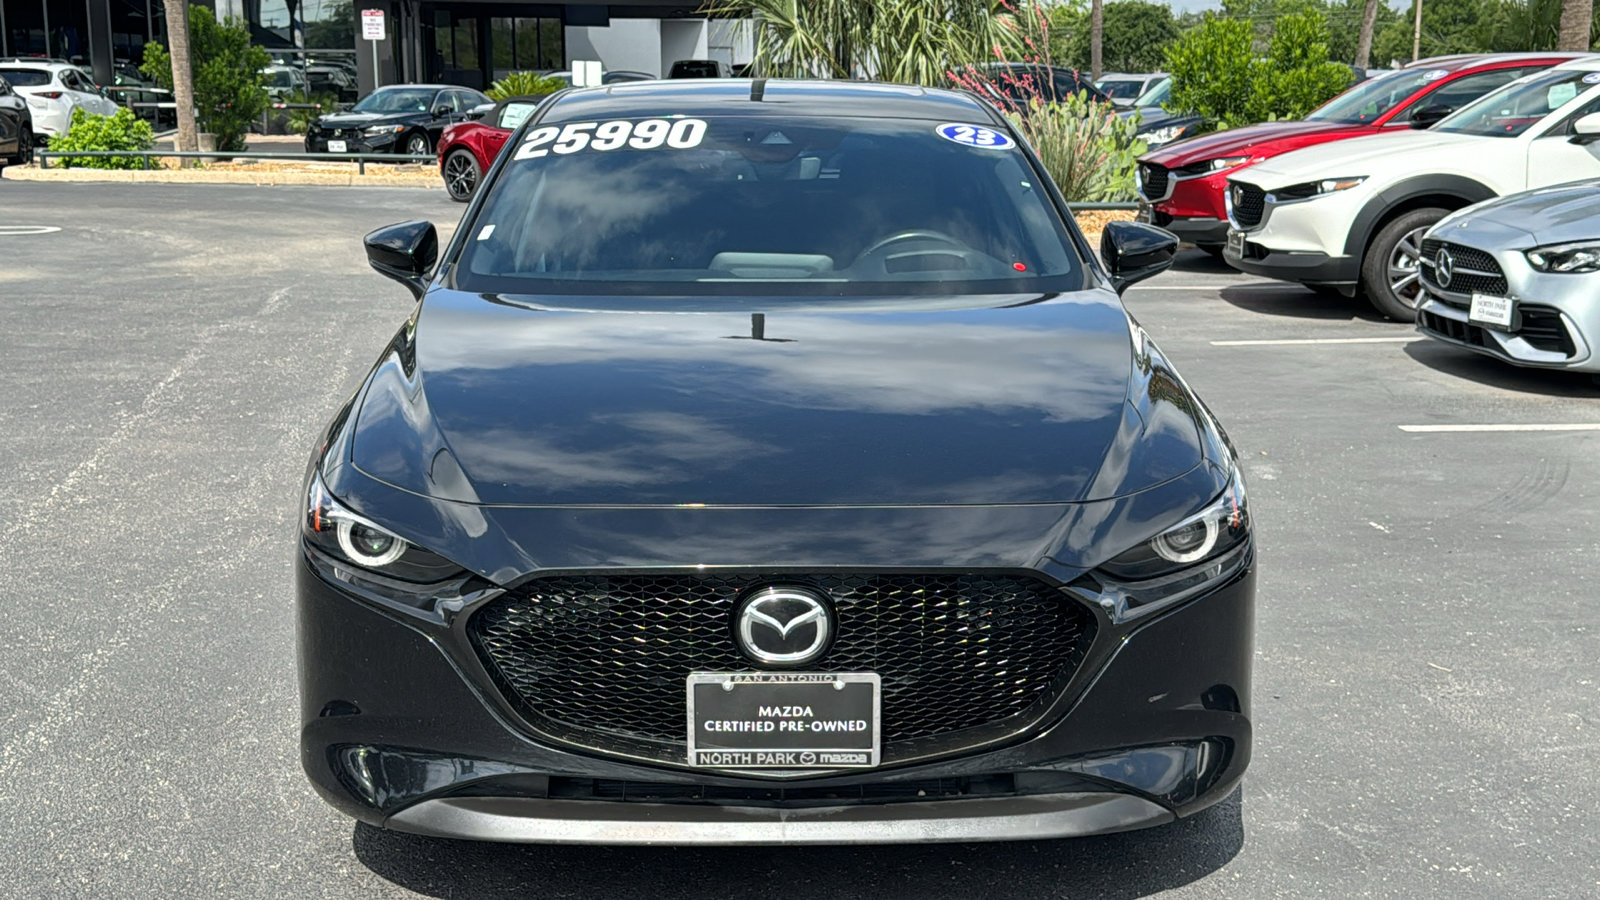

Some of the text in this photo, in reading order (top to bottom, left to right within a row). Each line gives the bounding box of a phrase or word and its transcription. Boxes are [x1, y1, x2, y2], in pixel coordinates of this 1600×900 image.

[514, 119, 708, 160] 25990
[953, 126, 996, 145] 23
[758, 706, 813, 717] MAZDA
[704, 720, 867, 732] CERTIFIED PRE-OWNED
[700, 753, 867, 764] NORTH PARK mazda
